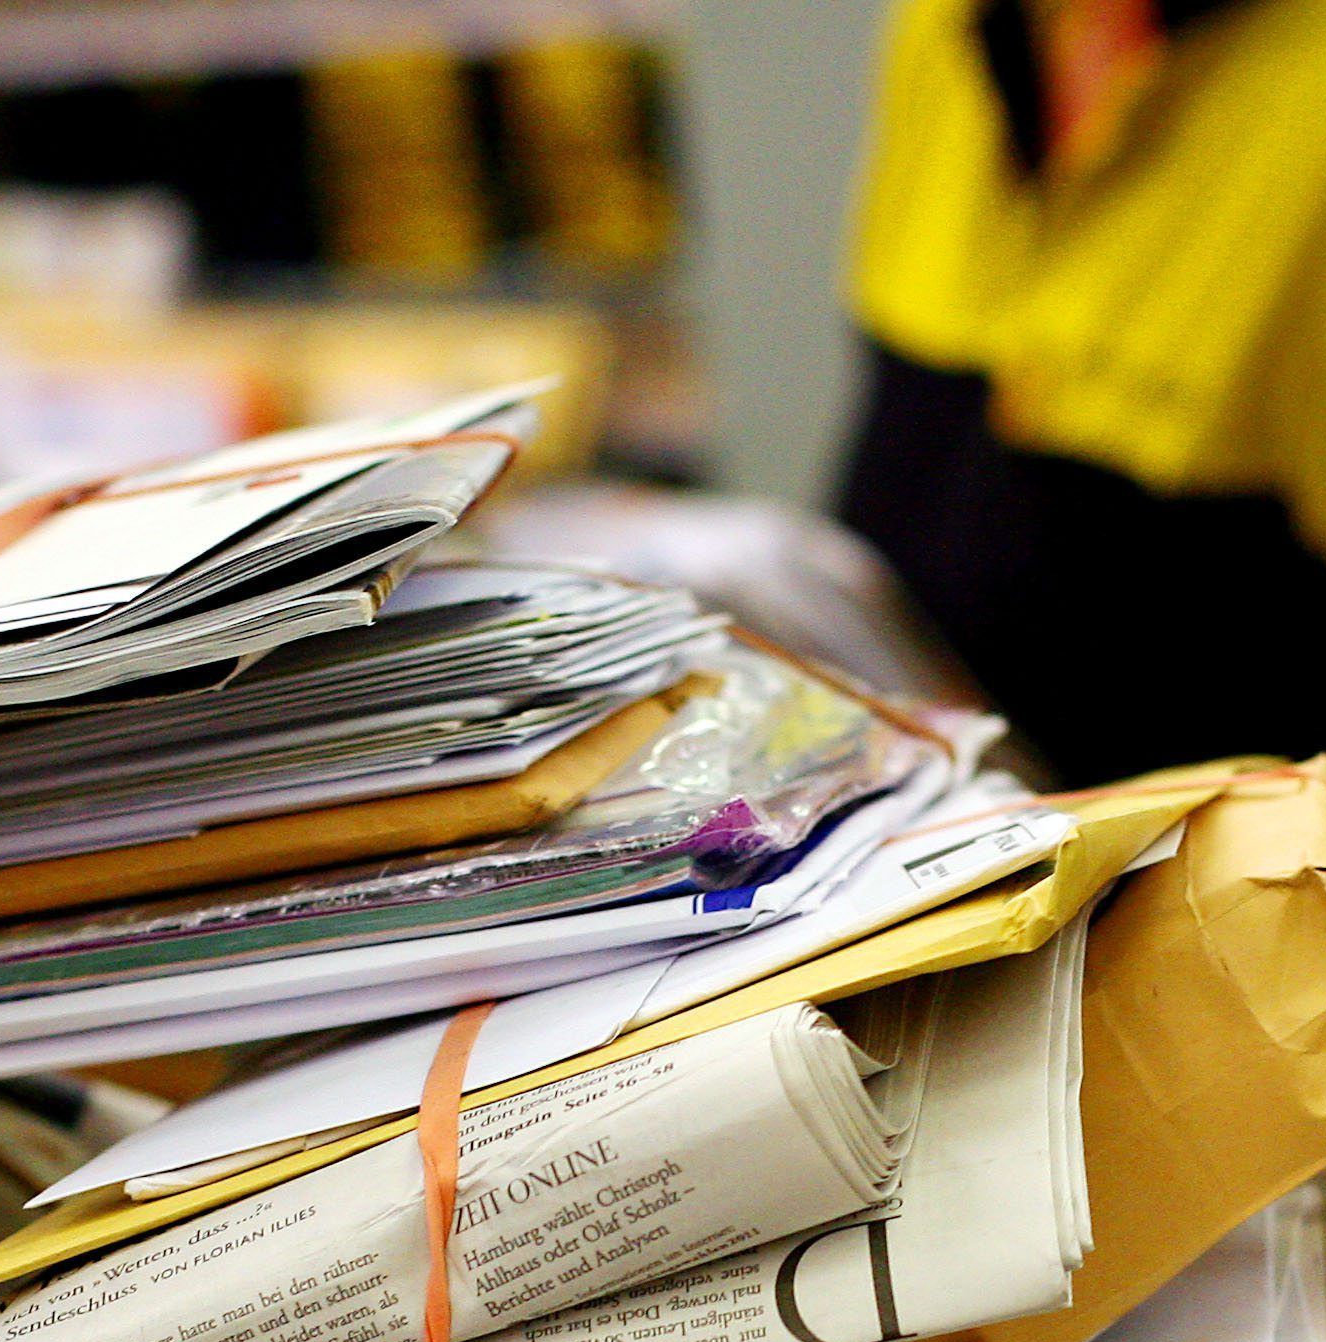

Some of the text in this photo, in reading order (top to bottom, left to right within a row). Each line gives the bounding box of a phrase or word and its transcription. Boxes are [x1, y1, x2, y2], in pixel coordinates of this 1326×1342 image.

[480, 1108, 514, 1128] dort
[614, 1056, 653, 1076] wird
[459, 1112, 552, 1158] ITmagazin
[565, 1090, 607, 1112] Seite
[450, 1136, 618, 1235] ZEIT ONLINE
[463, 1228, 545, 1271] Hamburg
[596, 1159, 682, 1208] Christoph
[48, 1285, 84, 1304] von
[188, 1221, 229, 1245] dass
[476, 1258, 541, 1297] Ahlhaus
[543, 1237, 580, 1263] oder
[582, 1211, 622, 1243] Olaf
[623, 1189, 682, 1224] Scholz
[6, 1285, 137, 1341] Sendeschluss
[151, 1261, 187, 1283] VON
[194, 1228, 264, 1266] FLORIAN
[271, 1205, 316, 1233] ILLIES
[484, 1279, 555, 1318] Berichte
[557, 1257, 594, 1284] und
[595, 1225, 670, 1267] Analysen
[626, 1269, 713, 1299] verlogenen
[721, 1263, 760, 1280] seine
[732, 1284, 761, 1304] mal
[177, 1318, 217, 1342] hatte
[222, 1302, 256, 1324] man
[258, 1286, 285, 1308] bei
[289, 1277, 318, 1296] den
[323, 1253, 379, 1282] rühren-
[258, 1308, 290, 1333] und
[293, 1301, 322, 1320] den
[326, 1274, 388, 1306] schnurr-
[325, 1306, 376, 1330] waren,
[378, 1290, 399, 1310] als
[596, 1314, 612, 1326] es
[617, 1305, 660, 1326] Doch
[690, 1305, 764, 1329] ständigen
[387, 1314, 409, 1331] sie
[566, 1317, 592, 1333] hat
[628, 1321, 686, 1340] Leuten.
